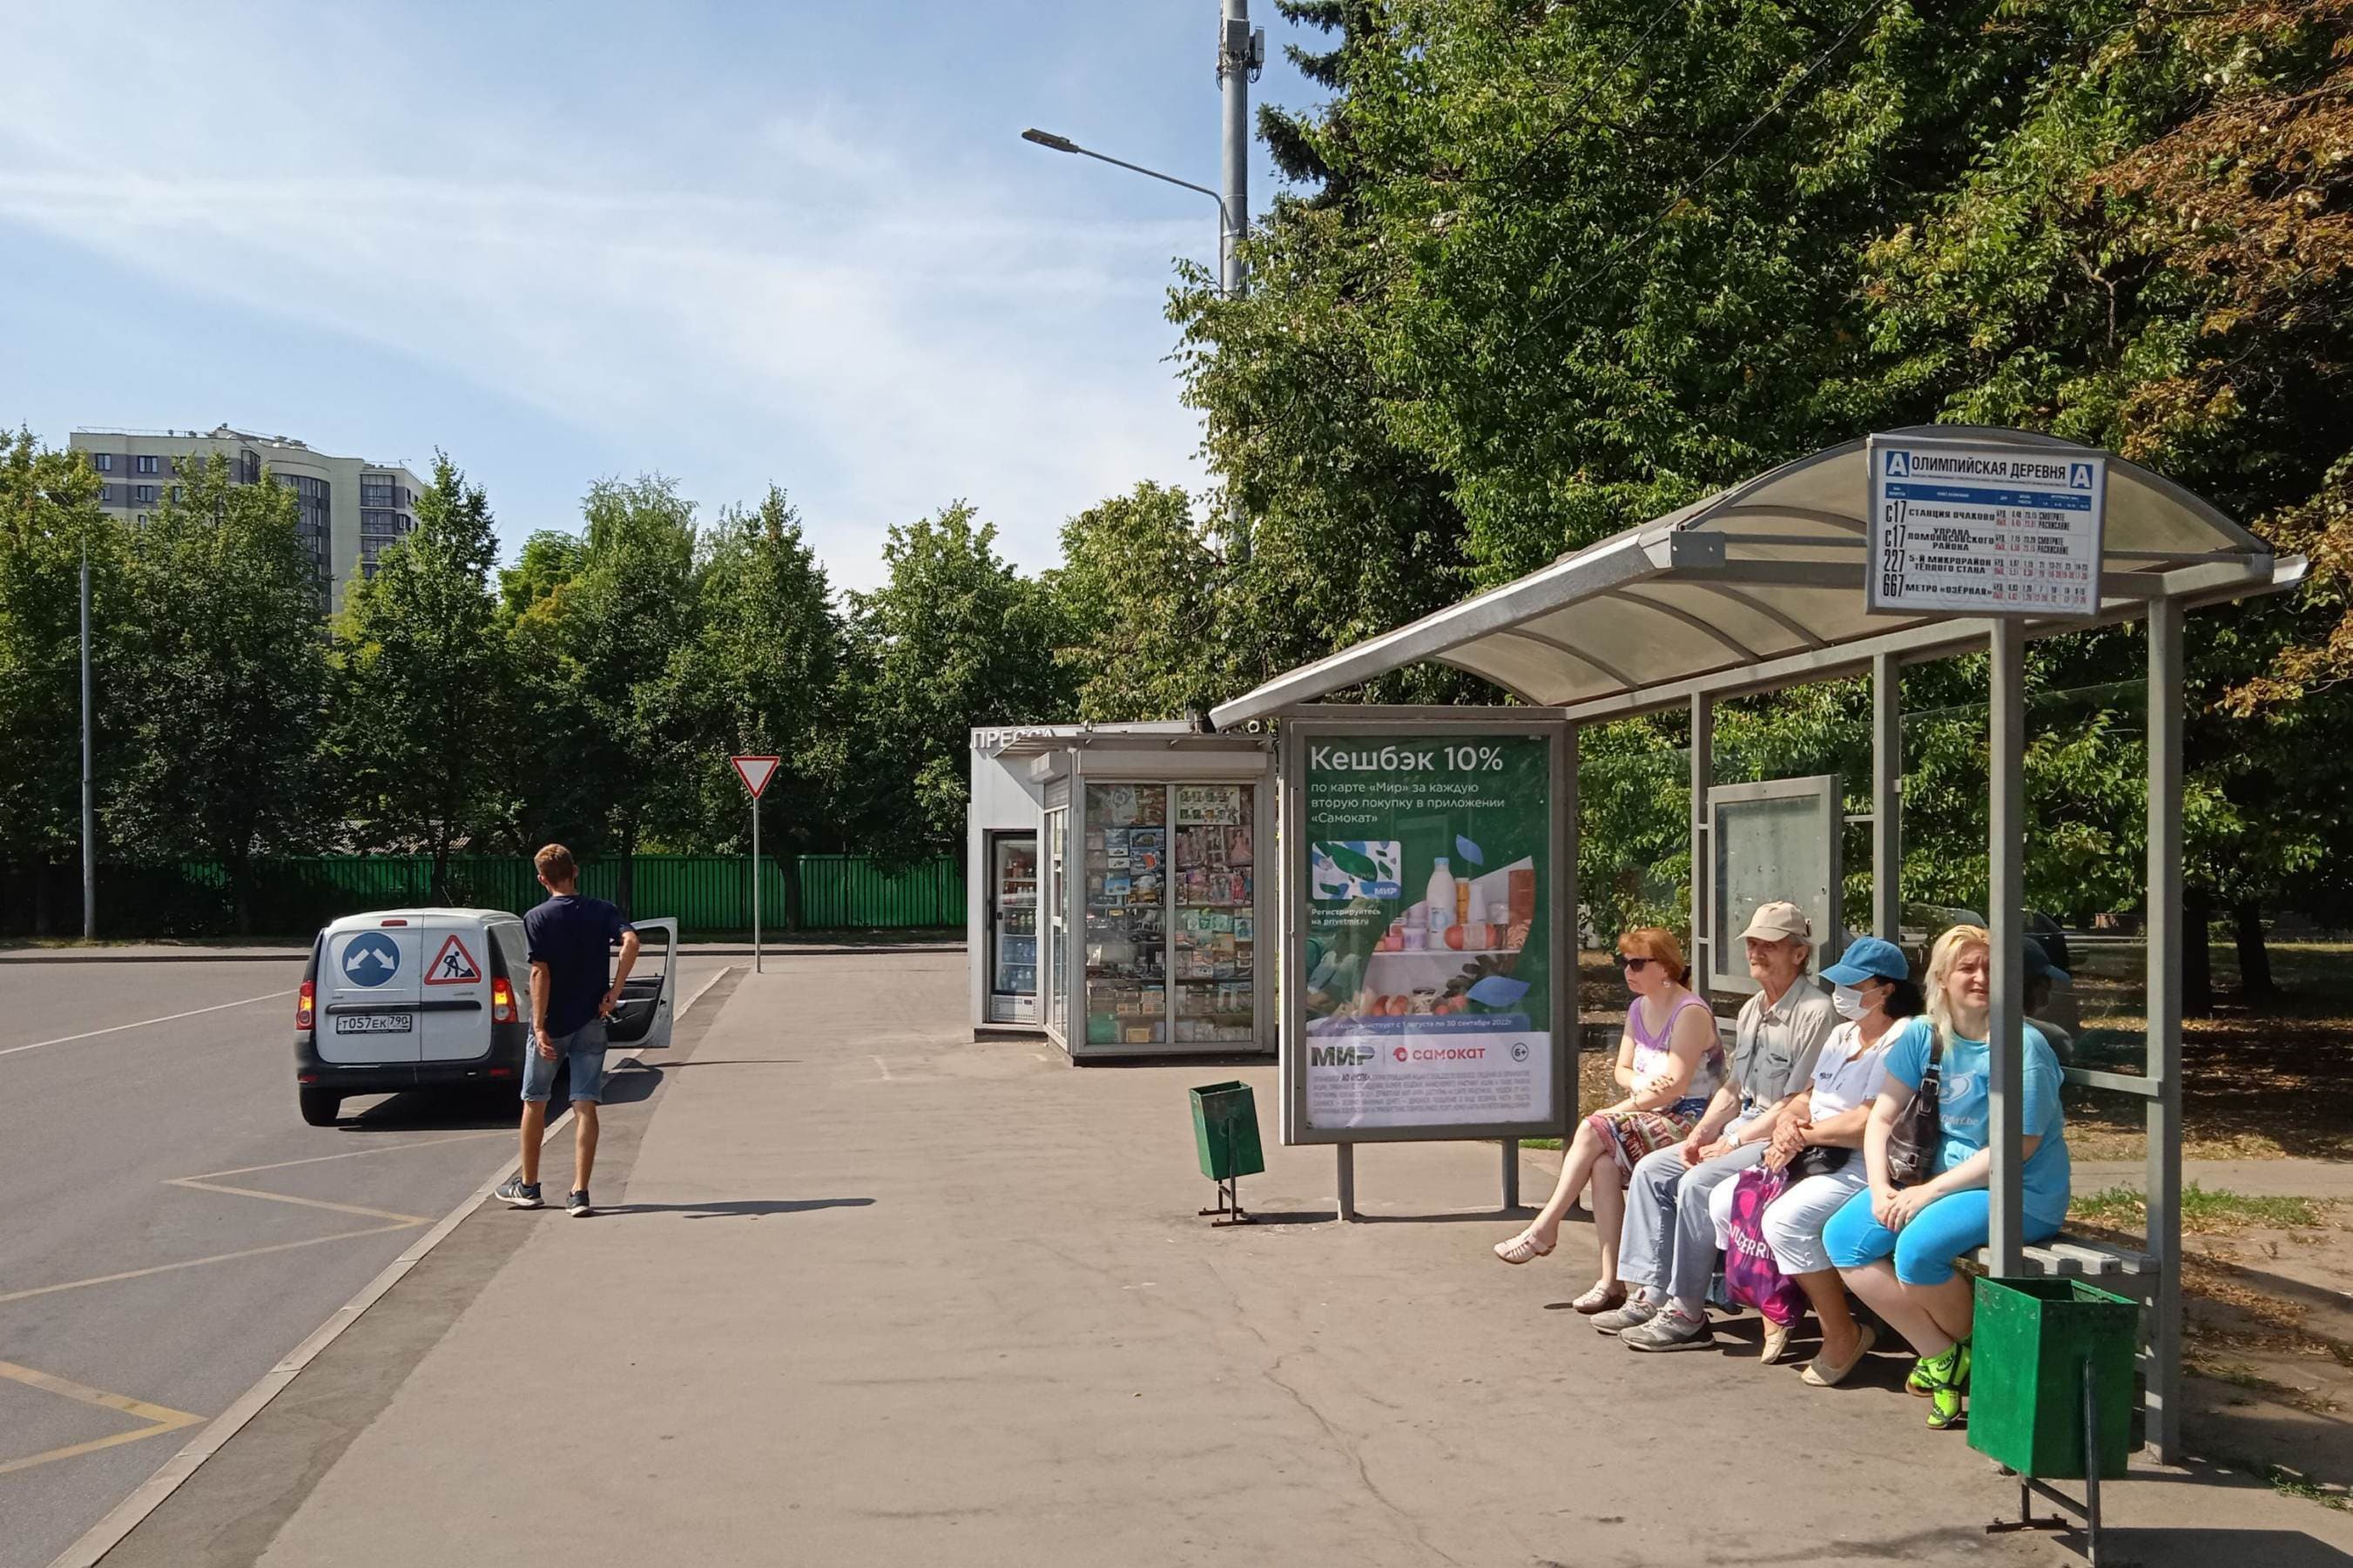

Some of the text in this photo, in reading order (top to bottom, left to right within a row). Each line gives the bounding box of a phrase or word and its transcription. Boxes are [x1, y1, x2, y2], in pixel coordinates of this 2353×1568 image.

[1911, 456, 2066, 479] ОЛИМПИЙСКАЯ ДЕРЕВНЯ
[1909, 508, 1951, 519] СТАНЦИЯ
[1953, 511, 1995, 521] ОЧАКОВО
[1933, 528, 1970, 536] УПРАВА
[1933, 542, 1969, 551] РАЙОНА
[1884, 548, 1905, 572] 227
[1927, 555, 1991, 566] МИКРОРАЙОН
[1883, 573, 1905, 597] 667
[1905, 583, 1938, 593] МЕТРО
[1311, 745, 1504, 771] Кешбэк 10%
[1311, 783, 1479, 795] по карте «Мир» за каждую
[1311, 798, 1505, 811] вторую покупку в приложении
[1311, 812, 1378, 824] «Самокат»
[1374, 887, 1398, 896] МИР
[1311, 908, 1381, 919] Регистрируйтесь
[1458, 1019, 1491, 1028] сентября
[1311, 1045, 1375, 1067] МИР
[1412, 1047, 1487, 1060] самокат
